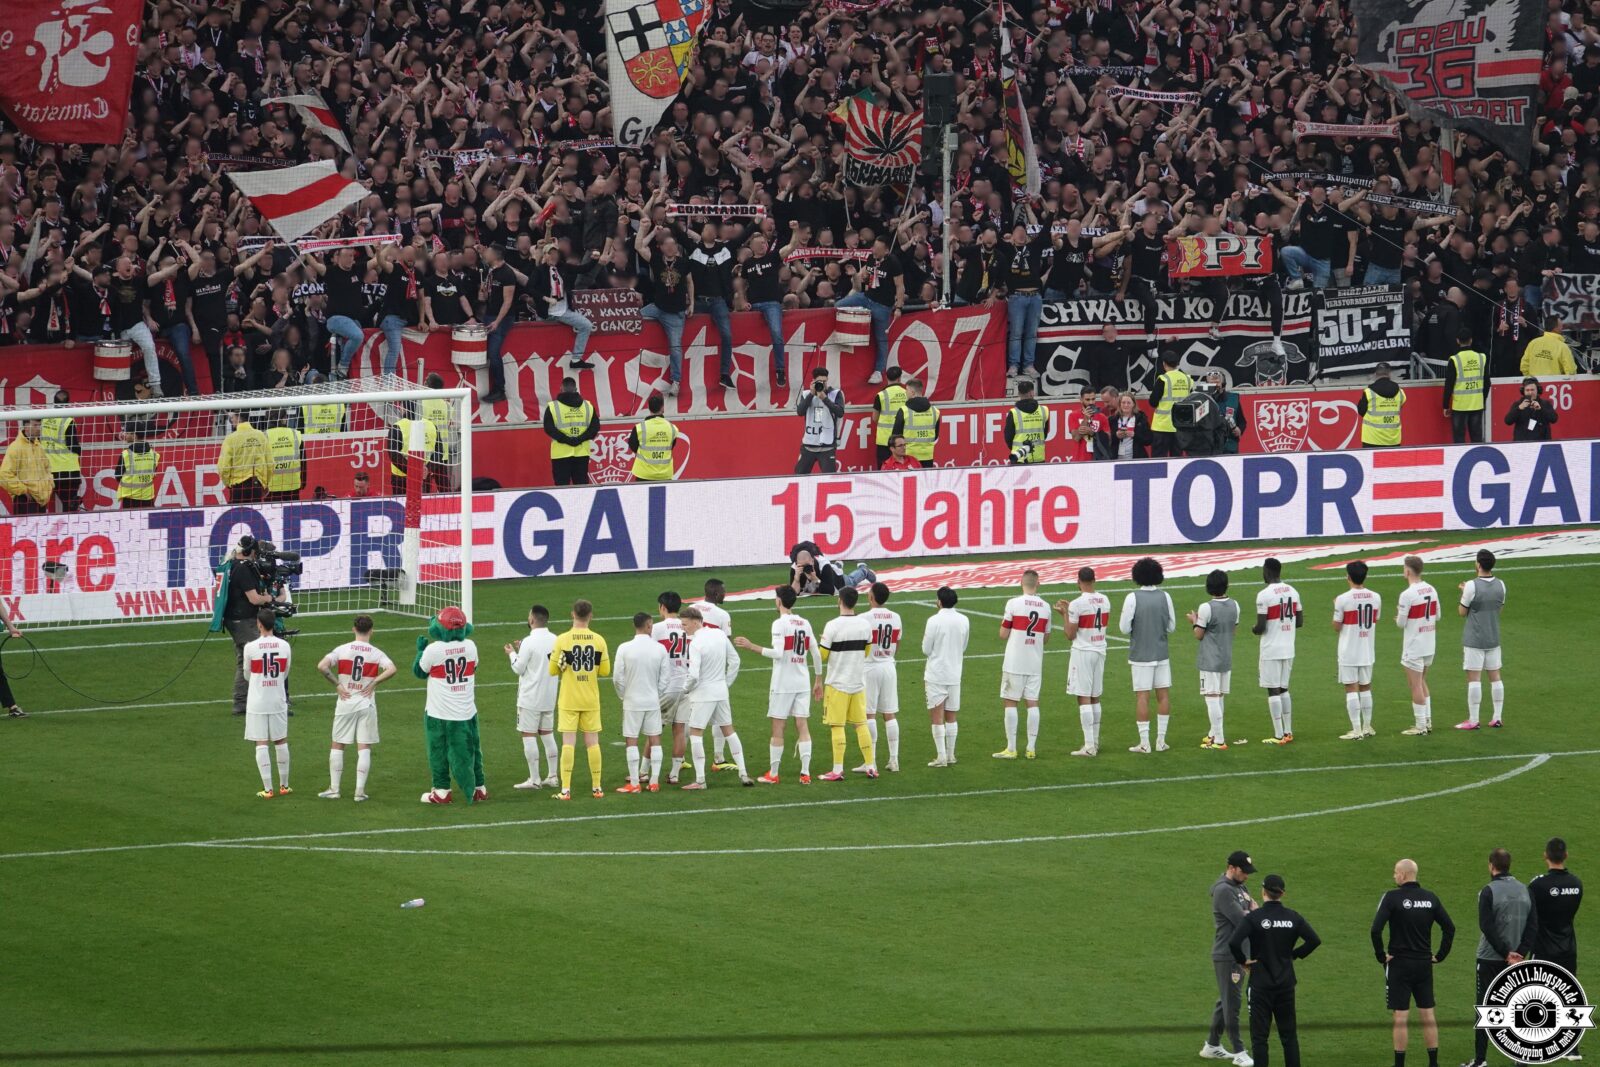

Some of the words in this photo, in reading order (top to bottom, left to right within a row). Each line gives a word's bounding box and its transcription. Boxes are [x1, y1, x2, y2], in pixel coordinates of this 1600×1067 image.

[1397, 46, 1476, 100] 36
[677, 205, 757, 215] COMMANDO
[1326, 299, 1377, 309] VERSTORBENEN
[1377, 294, 1403, 303] ULTRAS
[1361, 284, 1390, 295] ALLEN
[600, 307, 640, 318] KAMPF
[1317, 303, 1411, 346] 50+1
[600, 320, 643, 333] GANZE
[887, 311, 991, 402] 97
[1318, 337, 1411, 358] UNVERHANDELBAR
[1545, 384, 1573, 411] 36
[1257, 401, 1309, 432] VfB
[350, 440, 381, 470] 35
[771, 481, 855, 557] 15
[878, 473, 1081, 552] Jahre
[148, 484, 695, 592] TOPREGAL
[1094, 607, 1102, 633] 4
[1279, 596, 1294, 622] 14
[1356, 602, 1374, 630] 10
[1423, 595, 1432, 622] 7
[877, 623, 893, 650] 18
[1026, 610, 1040, 638] 2
[669, 631, 687, 659] 21
[793, 629, 806, 656] 16
[262, 652, 280, 678] 15
[351, 655, 365, 682] 6
[445, 656, 469, 684] 92
[572, 644, 595, 672] 33
[1413, 900, 1433, 909] JAKO
[1560, 887, 1580, 895] JAKO
[1272, 919, 1294, 929] JAKO
